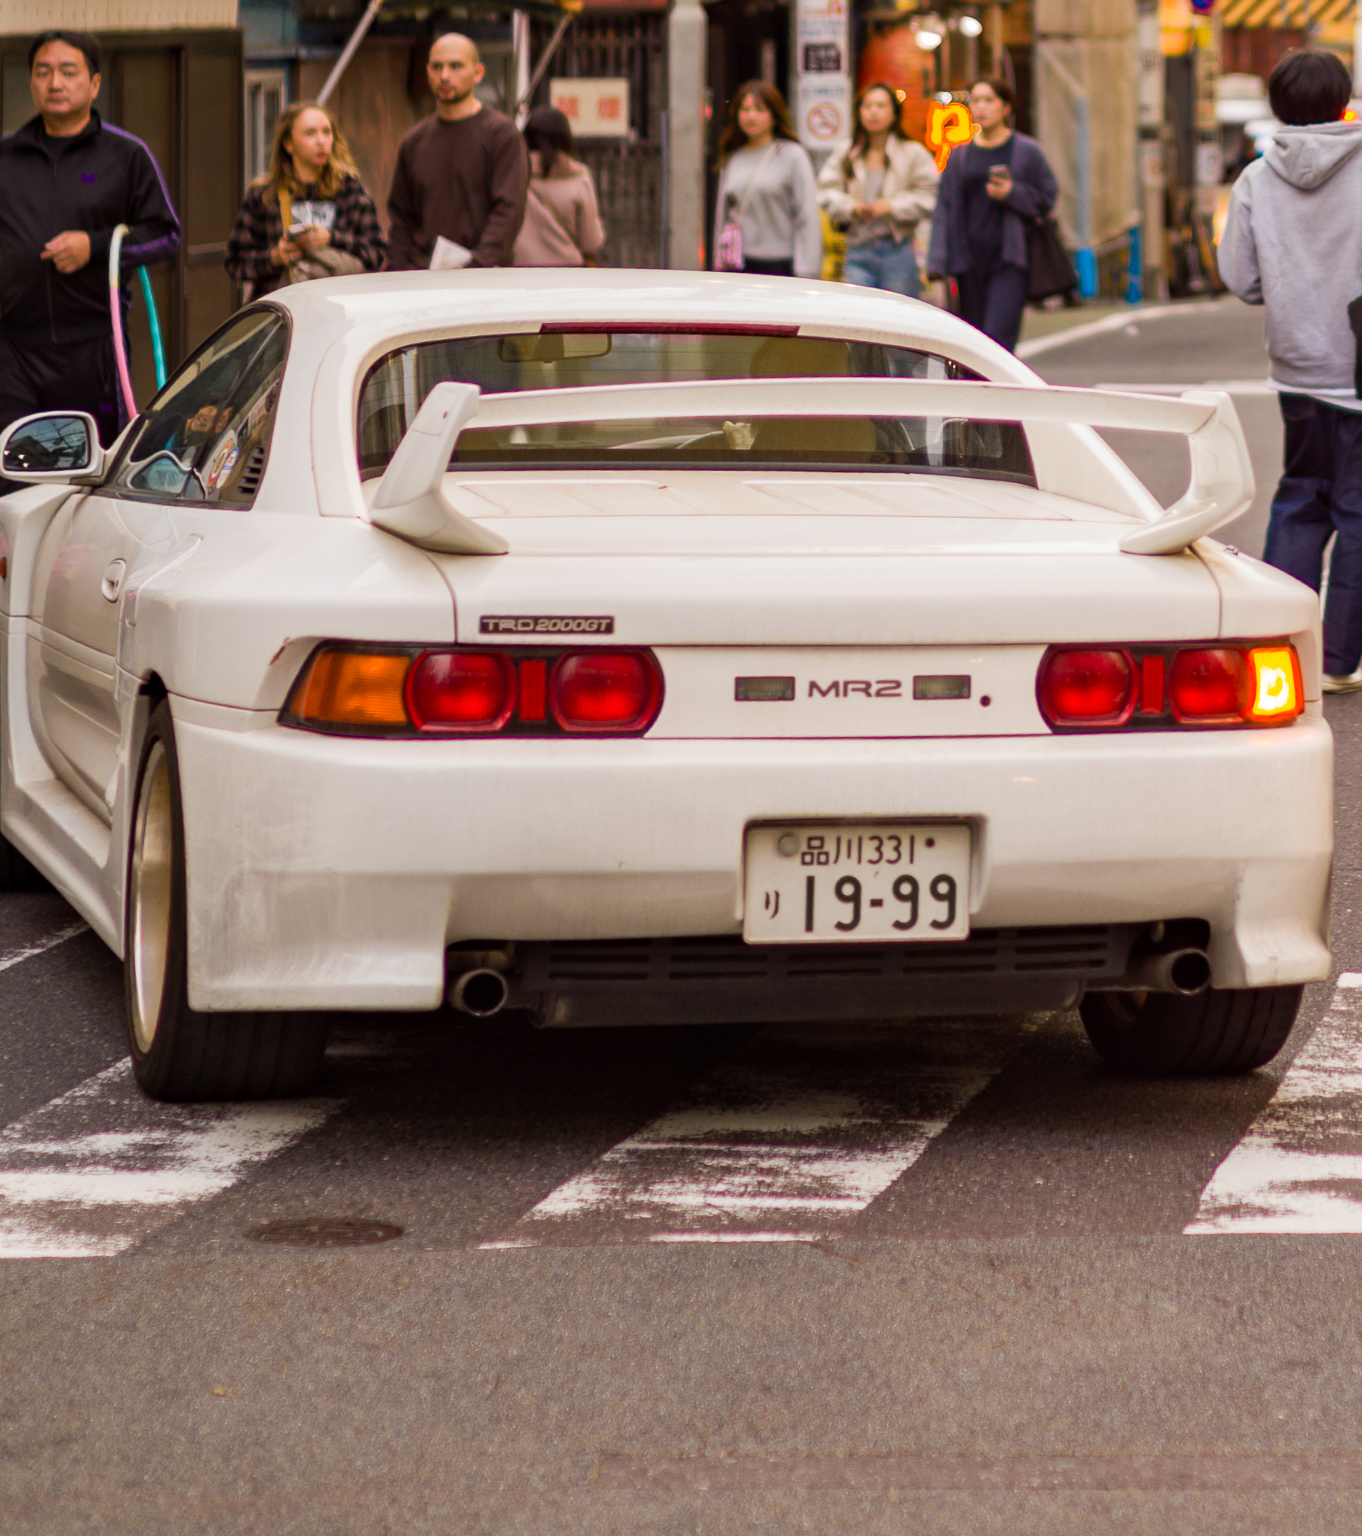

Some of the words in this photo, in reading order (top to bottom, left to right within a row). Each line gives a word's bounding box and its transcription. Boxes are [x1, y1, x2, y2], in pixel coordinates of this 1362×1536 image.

[808, 680, 902, 697] MR2
[764, 890, 780, 920] り
[804, 873, 957, 933] 19-99
